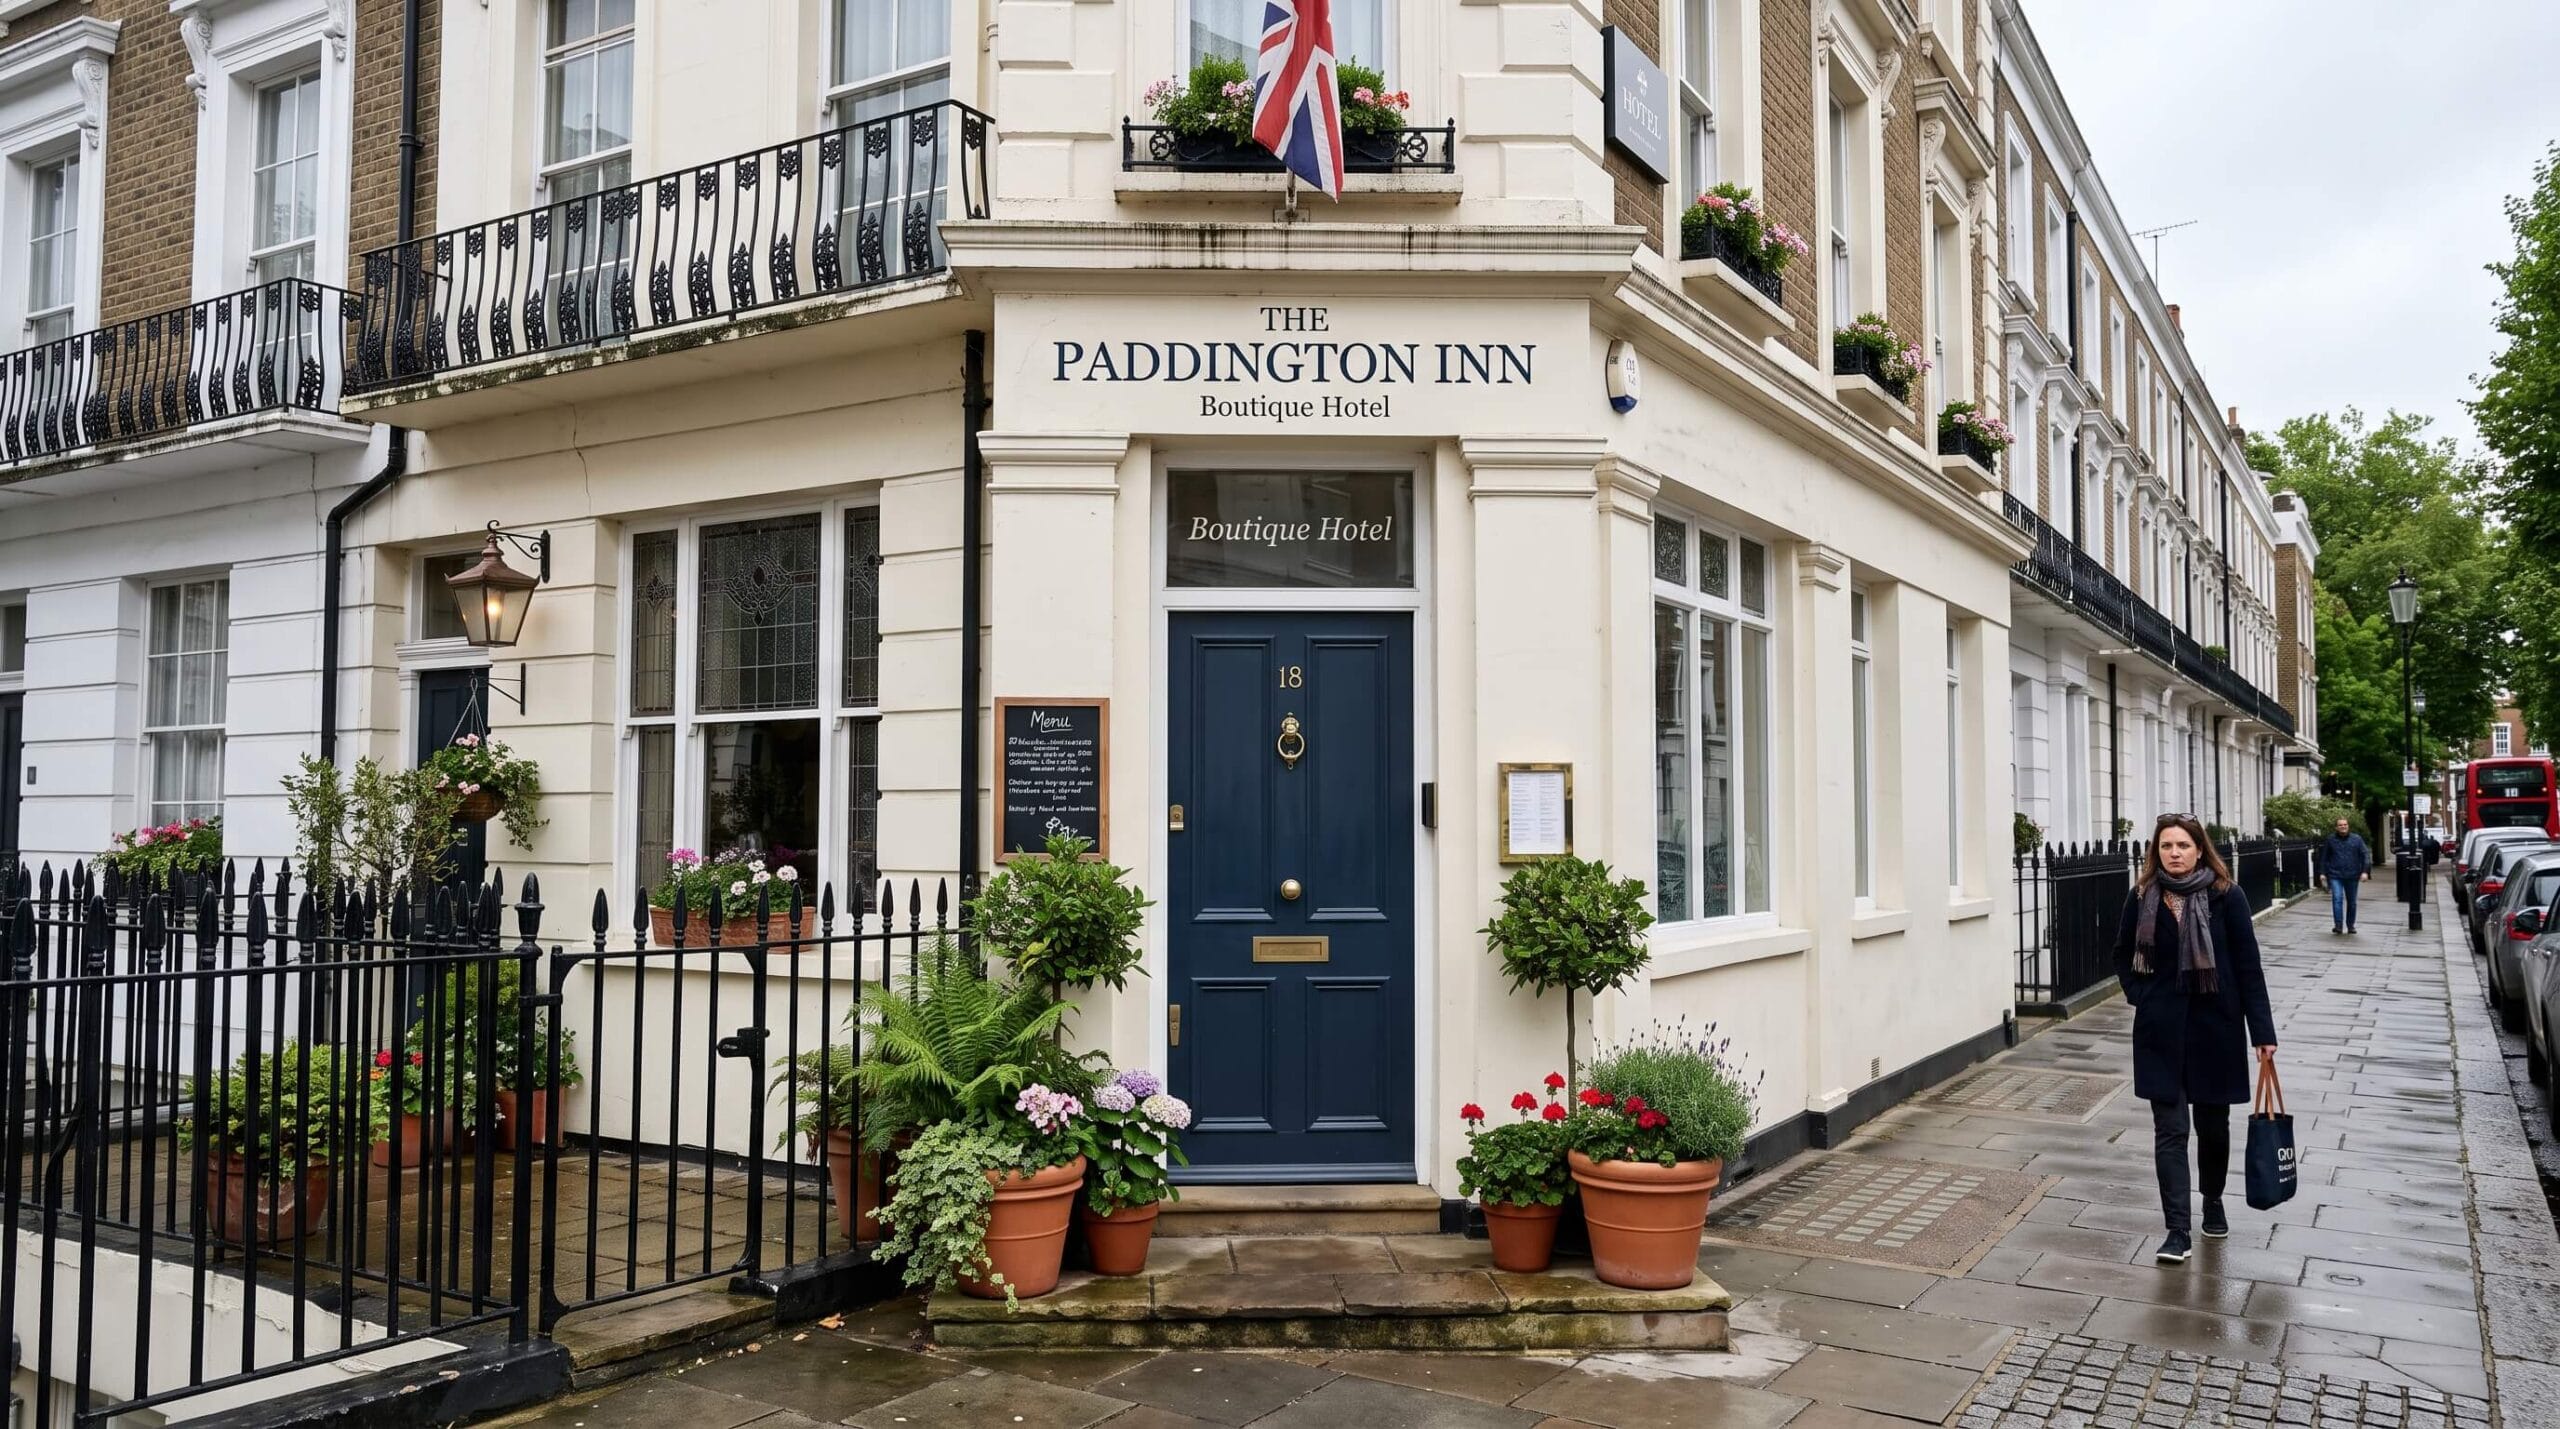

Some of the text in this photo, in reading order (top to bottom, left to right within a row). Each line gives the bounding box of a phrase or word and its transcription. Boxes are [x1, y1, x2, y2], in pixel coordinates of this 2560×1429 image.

[1622, 86, 1662, 140] HOTEL
[1260, 306, 1329, 332] THE
[1053, 341, 1537, 385] PADDINGTON INN
[1200, 394, 1391, 423] Boutique Hotel
[1188, 516, 1392, 547] Boutique Hotel
[1279, 666, 1302, 688] 18
[1030, 710, 1073, 733] Menu
